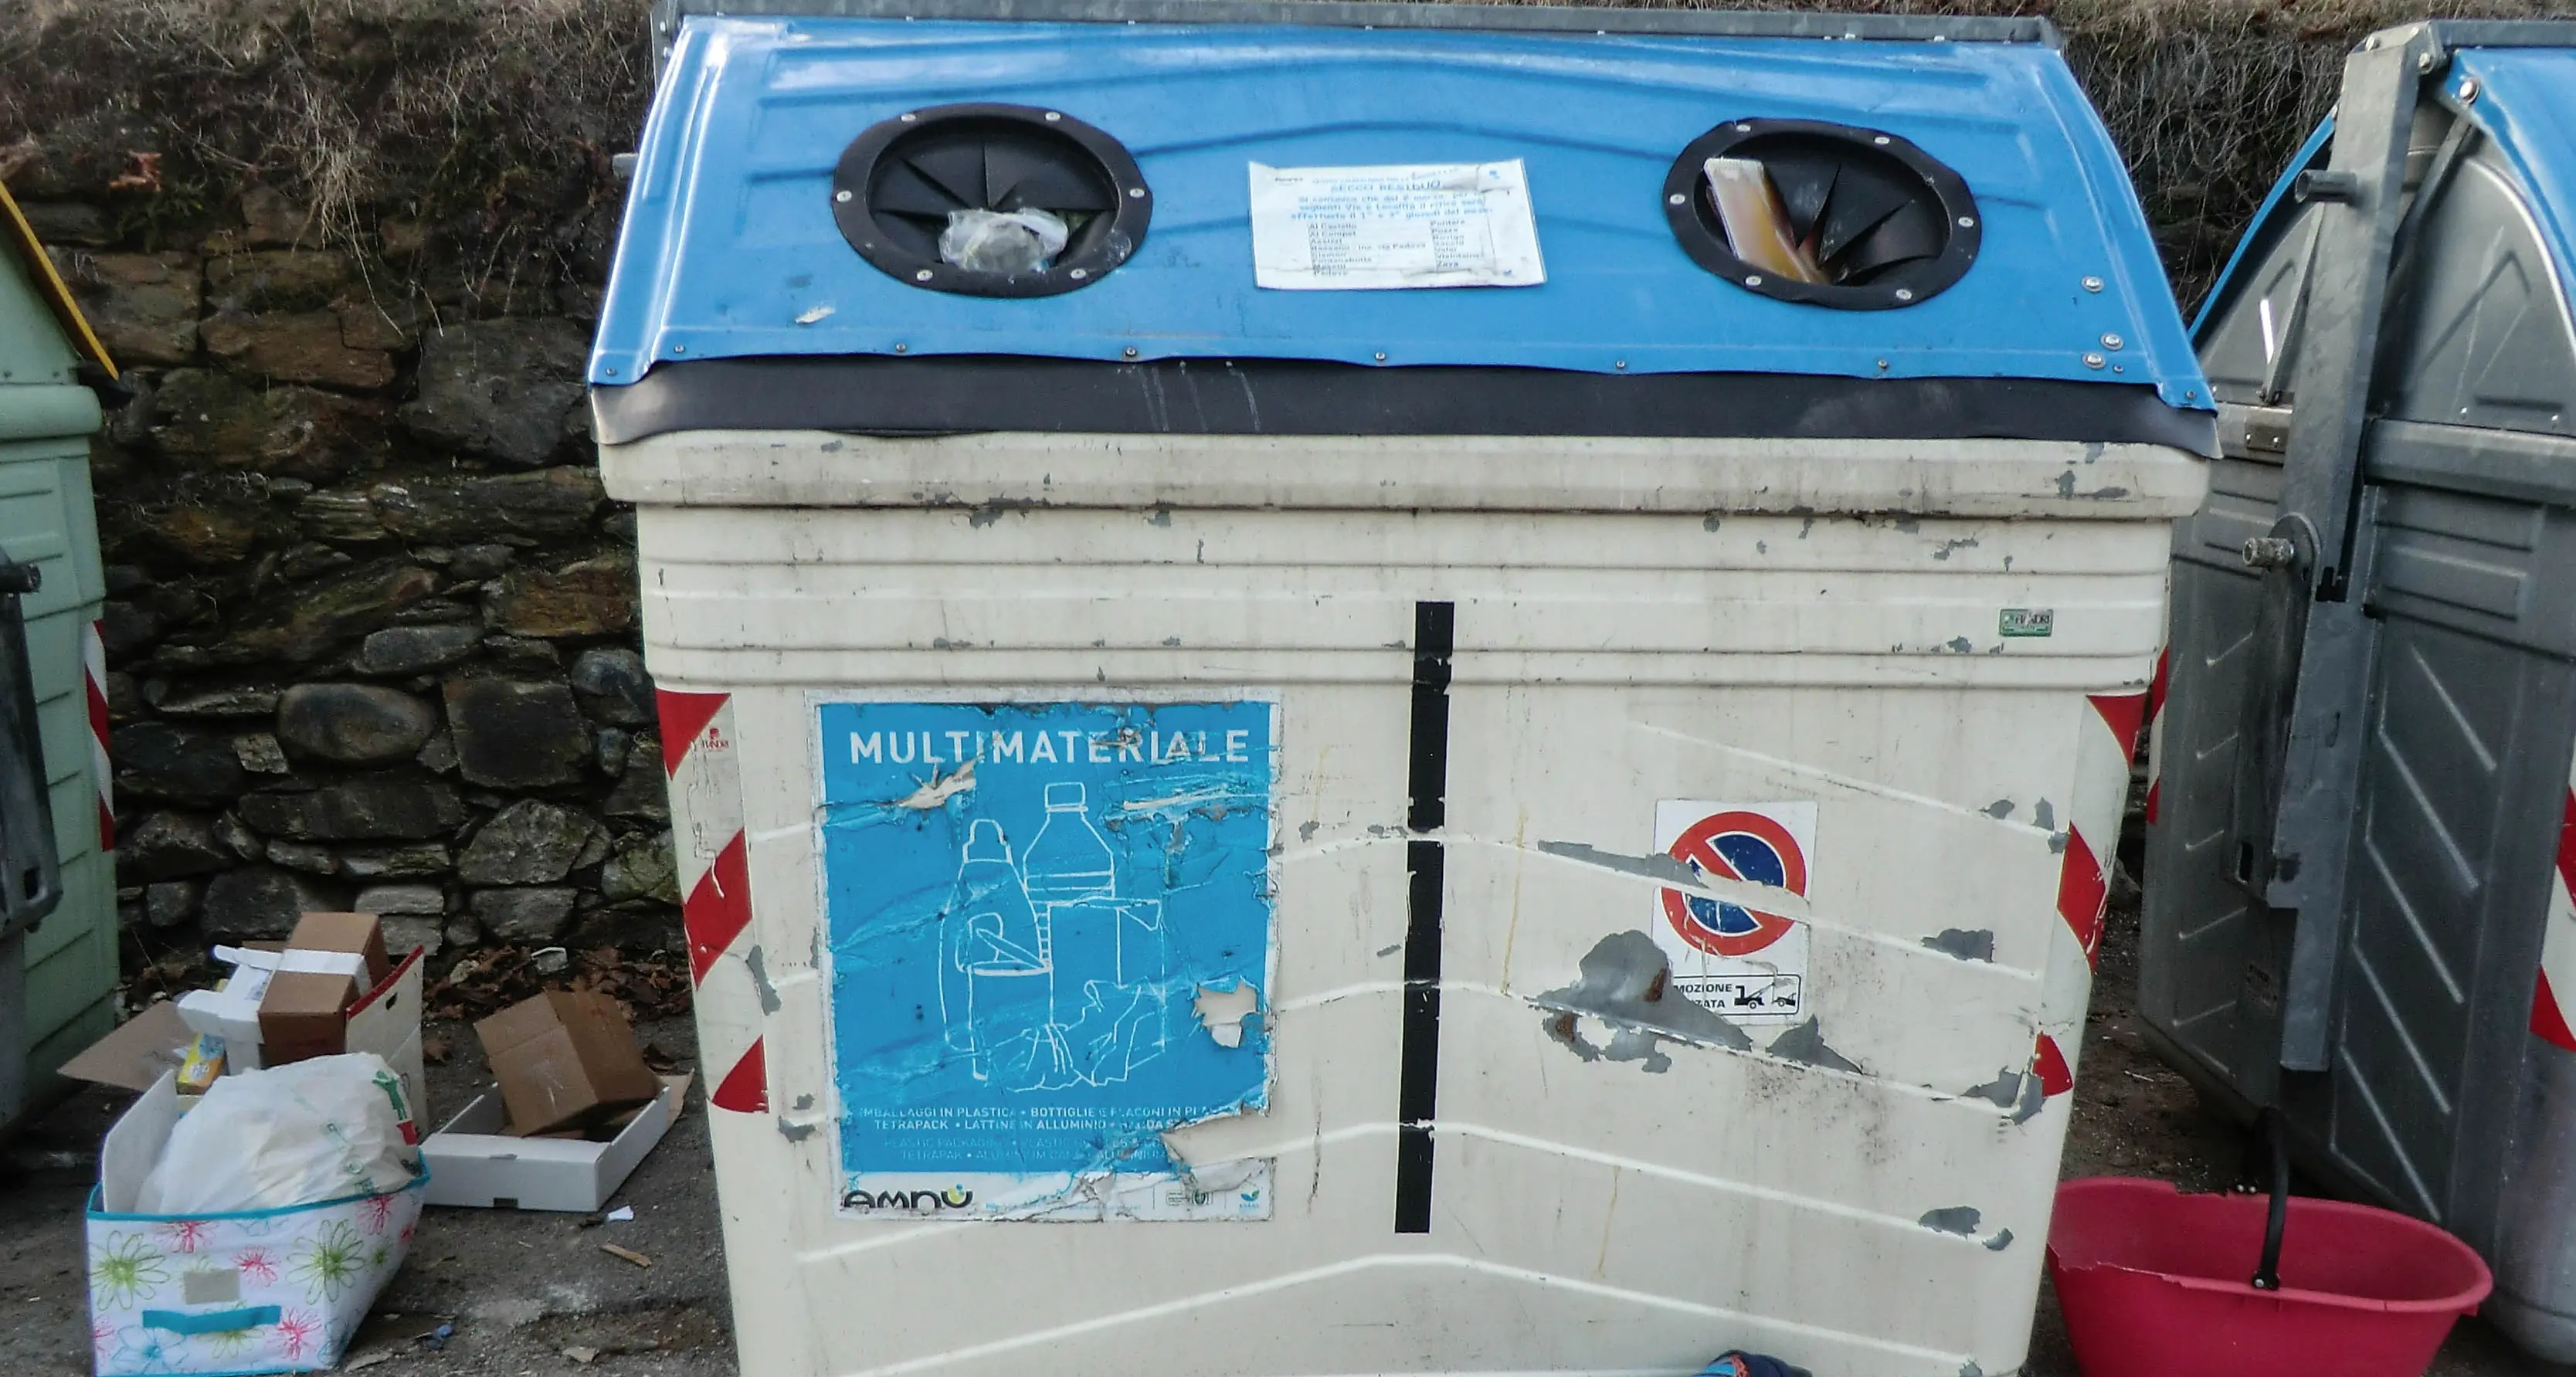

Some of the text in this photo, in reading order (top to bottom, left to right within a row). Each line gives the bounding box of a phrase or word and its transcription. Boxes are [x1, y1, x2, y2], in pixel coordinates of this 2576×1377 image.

[1298, 205, 1341, 213] seguenti
[850, 731, 1249, 765] MULTIMATERIALE
[940, 1107, 953, 1118] IN
[957, 1107, 1016, 1118] PLASTICA
[1031, 1107, 1095, 1118] BOTTIGLIE
[1168, 1107, 1181, 1117] IN
[874, 1120, 949, 1130] TETRAPACK
[965, 1120, 1014, 1130] LATTINE
[1037, 1120, 1106, 1130] ALLUMINIO
